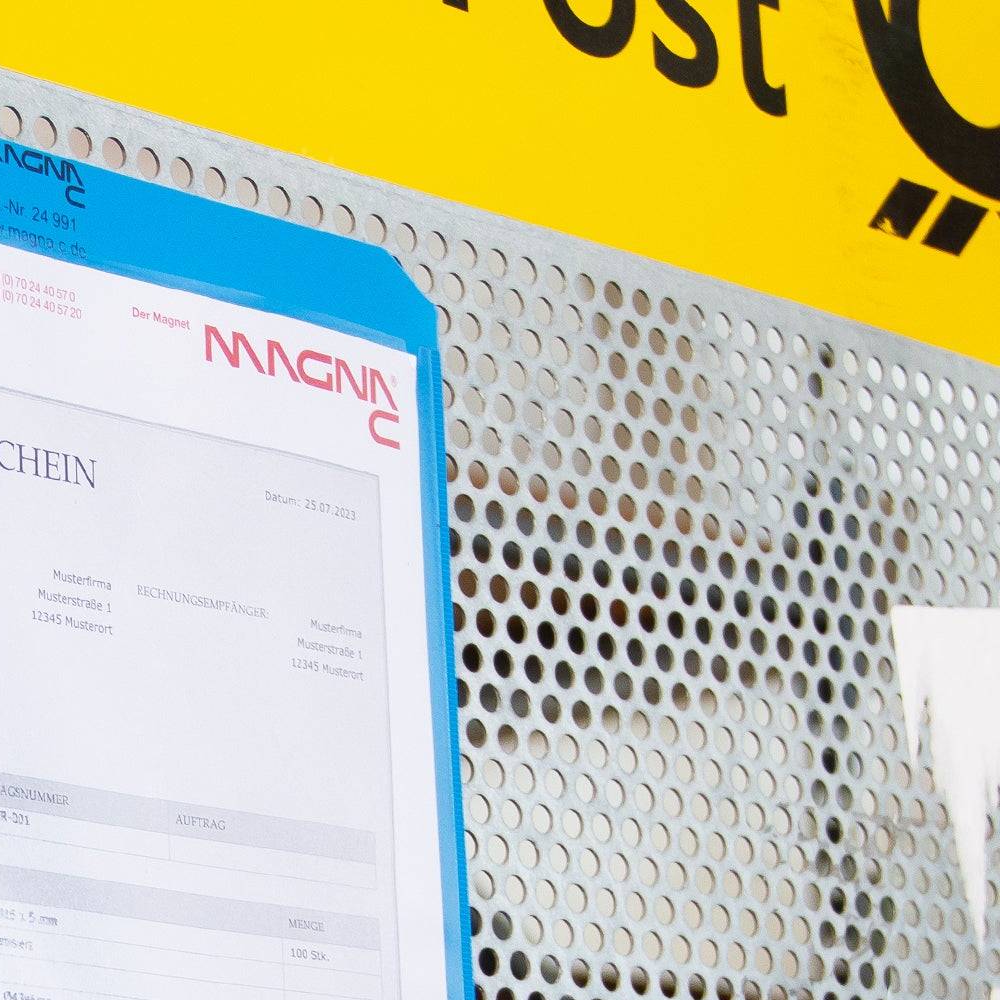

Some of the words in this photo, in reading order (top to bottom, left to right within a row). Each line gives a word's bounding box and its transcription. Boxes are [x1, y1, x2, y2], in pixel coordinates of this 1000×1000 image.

[442, 0, 788, 117] ost
[64, 185, 86, 209] C
[31, 206, 48, 225] 24
[52, 212, 77, 232] 991
[132, 306, 151, 320] Der
[152, 311, 191, 330] Magnet
[204, 324, 399, 411] MAGNA
[368, 409, 400, 450] C
[265, 490, 302, 507] Datum:
[304, 498, 356, 521] 25.07.2023
[53, 569, 112, 590] Musterfirma
[38, 588, 103, 612] Musterstraße
[31, 610, 62, 625] 12345
[65, 616, 113, 635] Musterort
[310, 619, 362, 639] Musterfirma
[297, 637, 355, 658] Musterstraße
[291, 657, 319, 672] 12345
[322, 664, 364, 682] Musterort
[175, 813, 226, 831] AUFTRAG
[288, 918, 325, 932] MENGE
[290, 948, 308, 960] 100
[311, 950, 330, 962] Stk.
